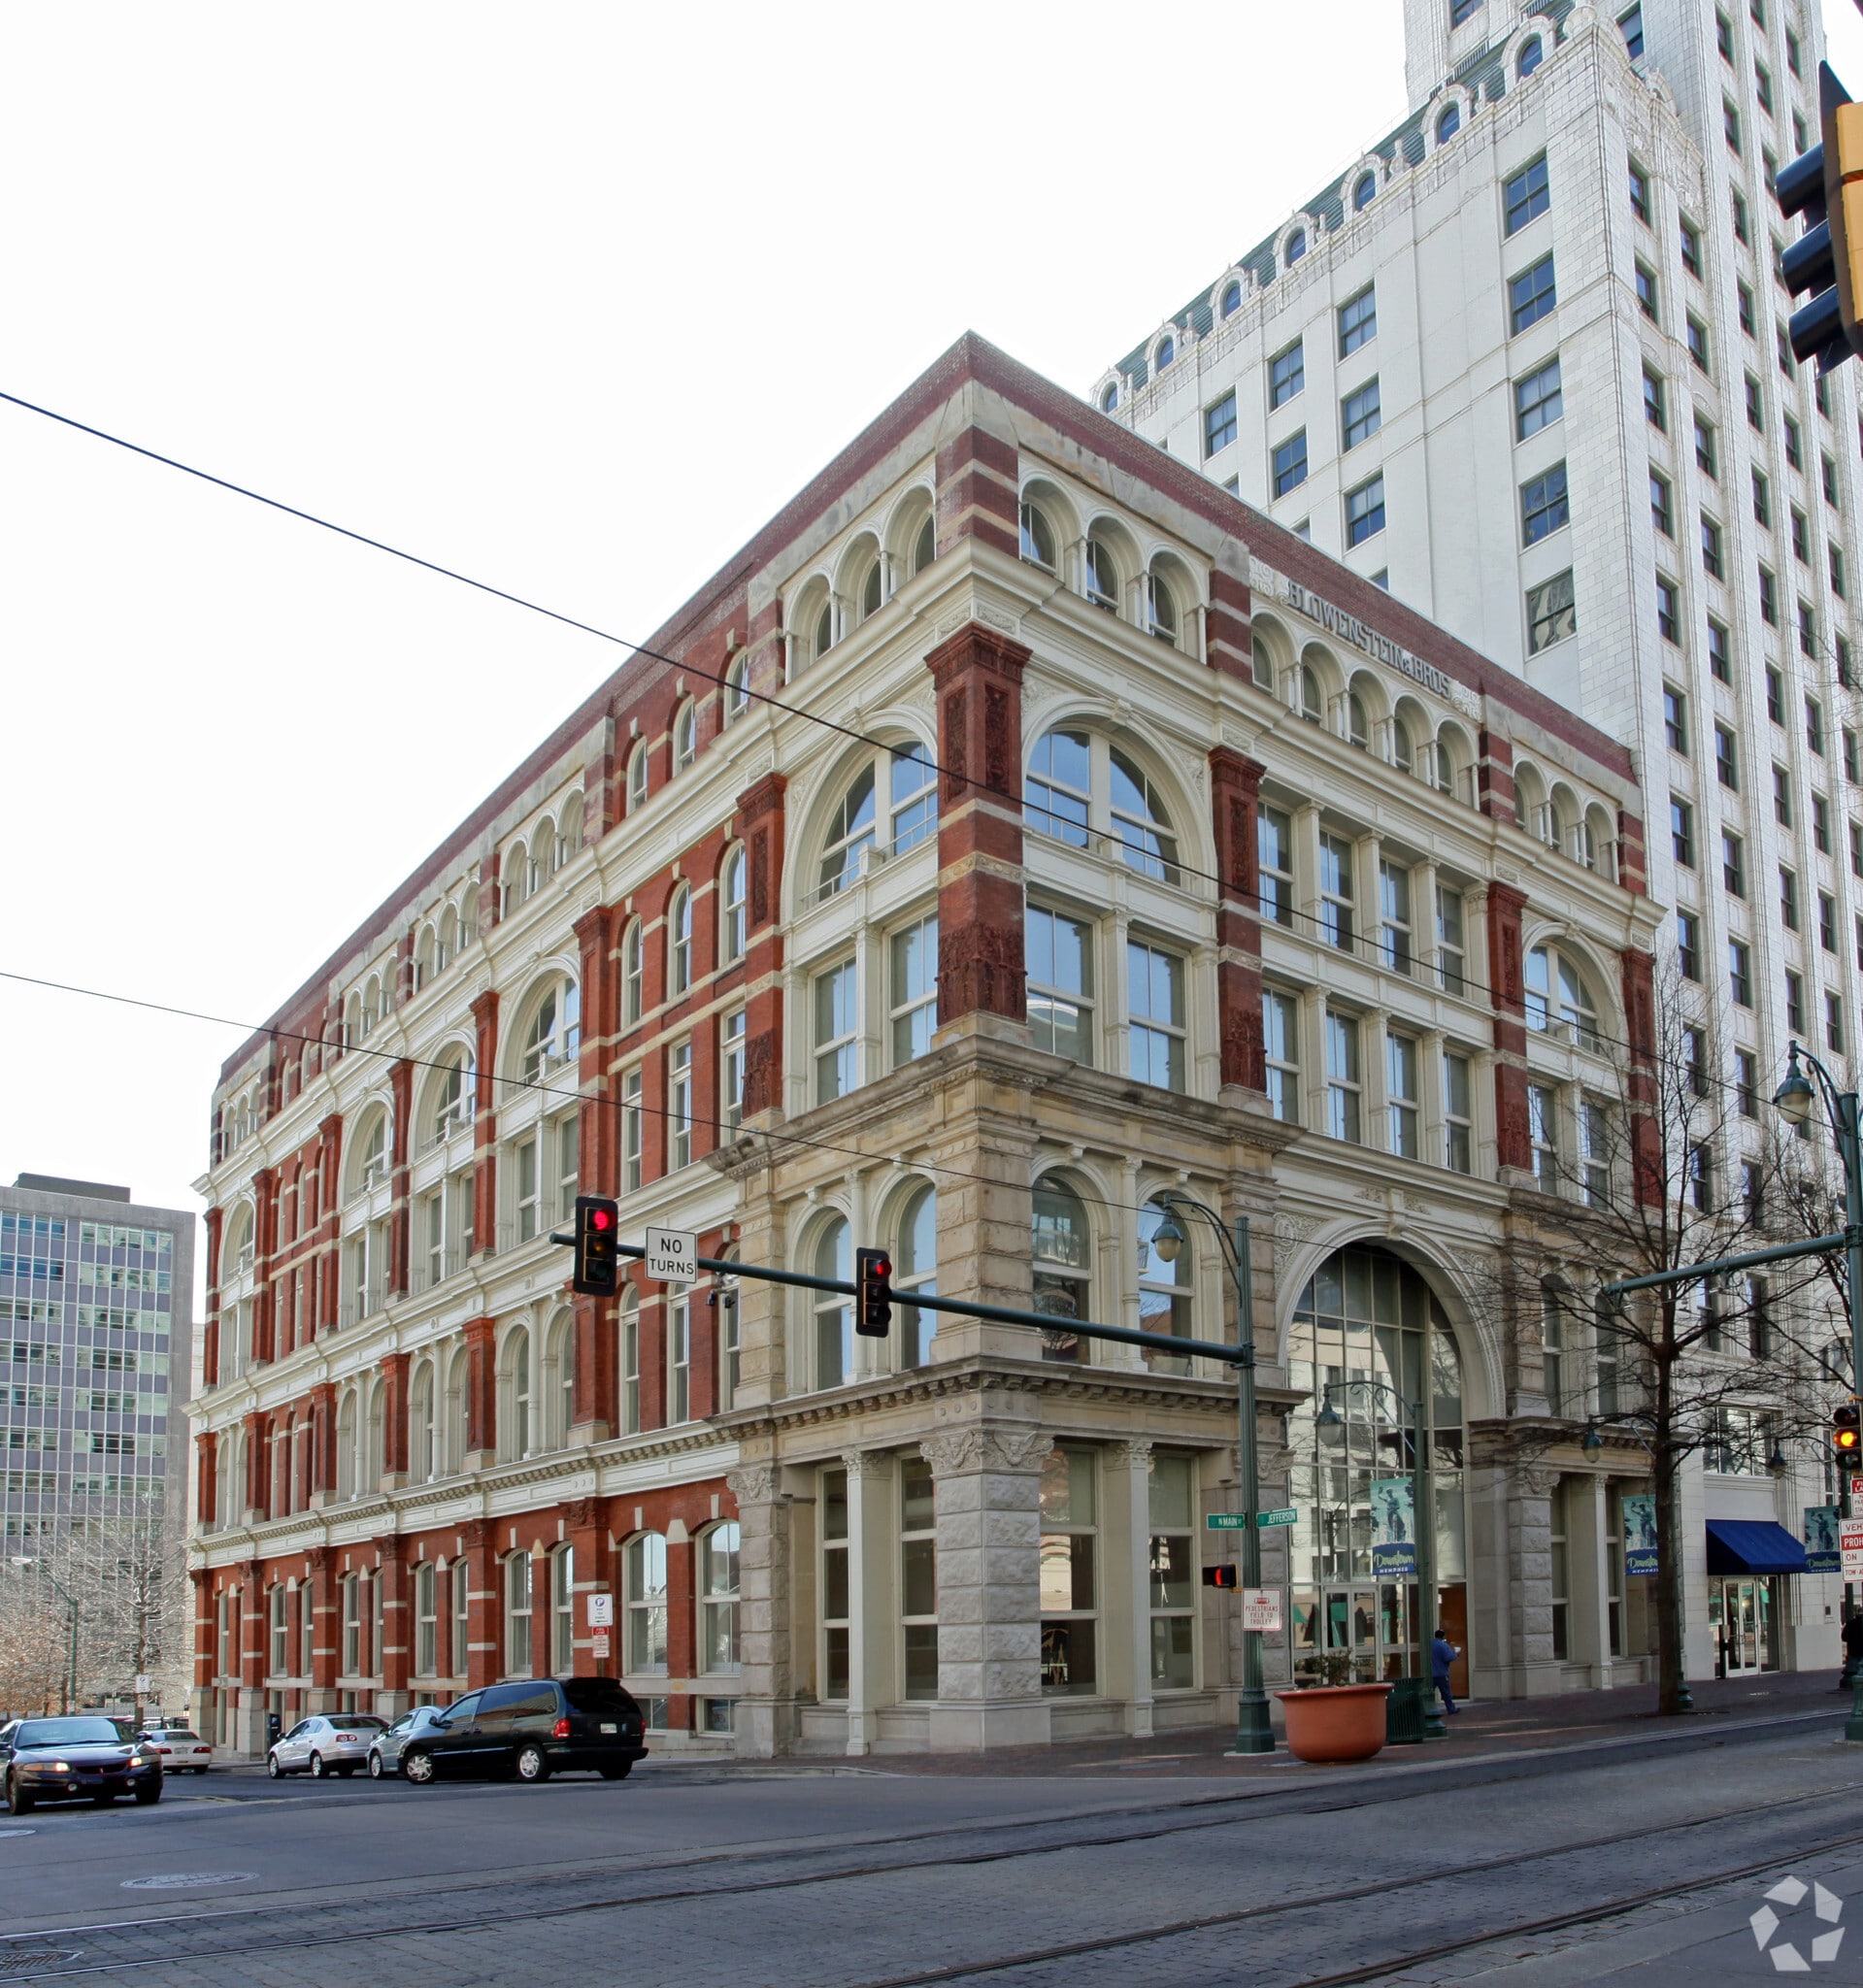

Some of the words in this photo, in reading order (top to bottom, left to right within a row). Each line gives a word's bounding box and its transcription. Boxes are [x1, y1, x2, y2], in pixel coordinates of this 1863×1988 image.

[660, 1238, 682, 1253] NO
[649, 1258, 694, 1275] TURNS
[1223, 1516, 1238, 1527] MAIN
[1268, 1510, 1296, 1524] JEFFERSON
[1374, 1550, 1414, 1568] Downtown
